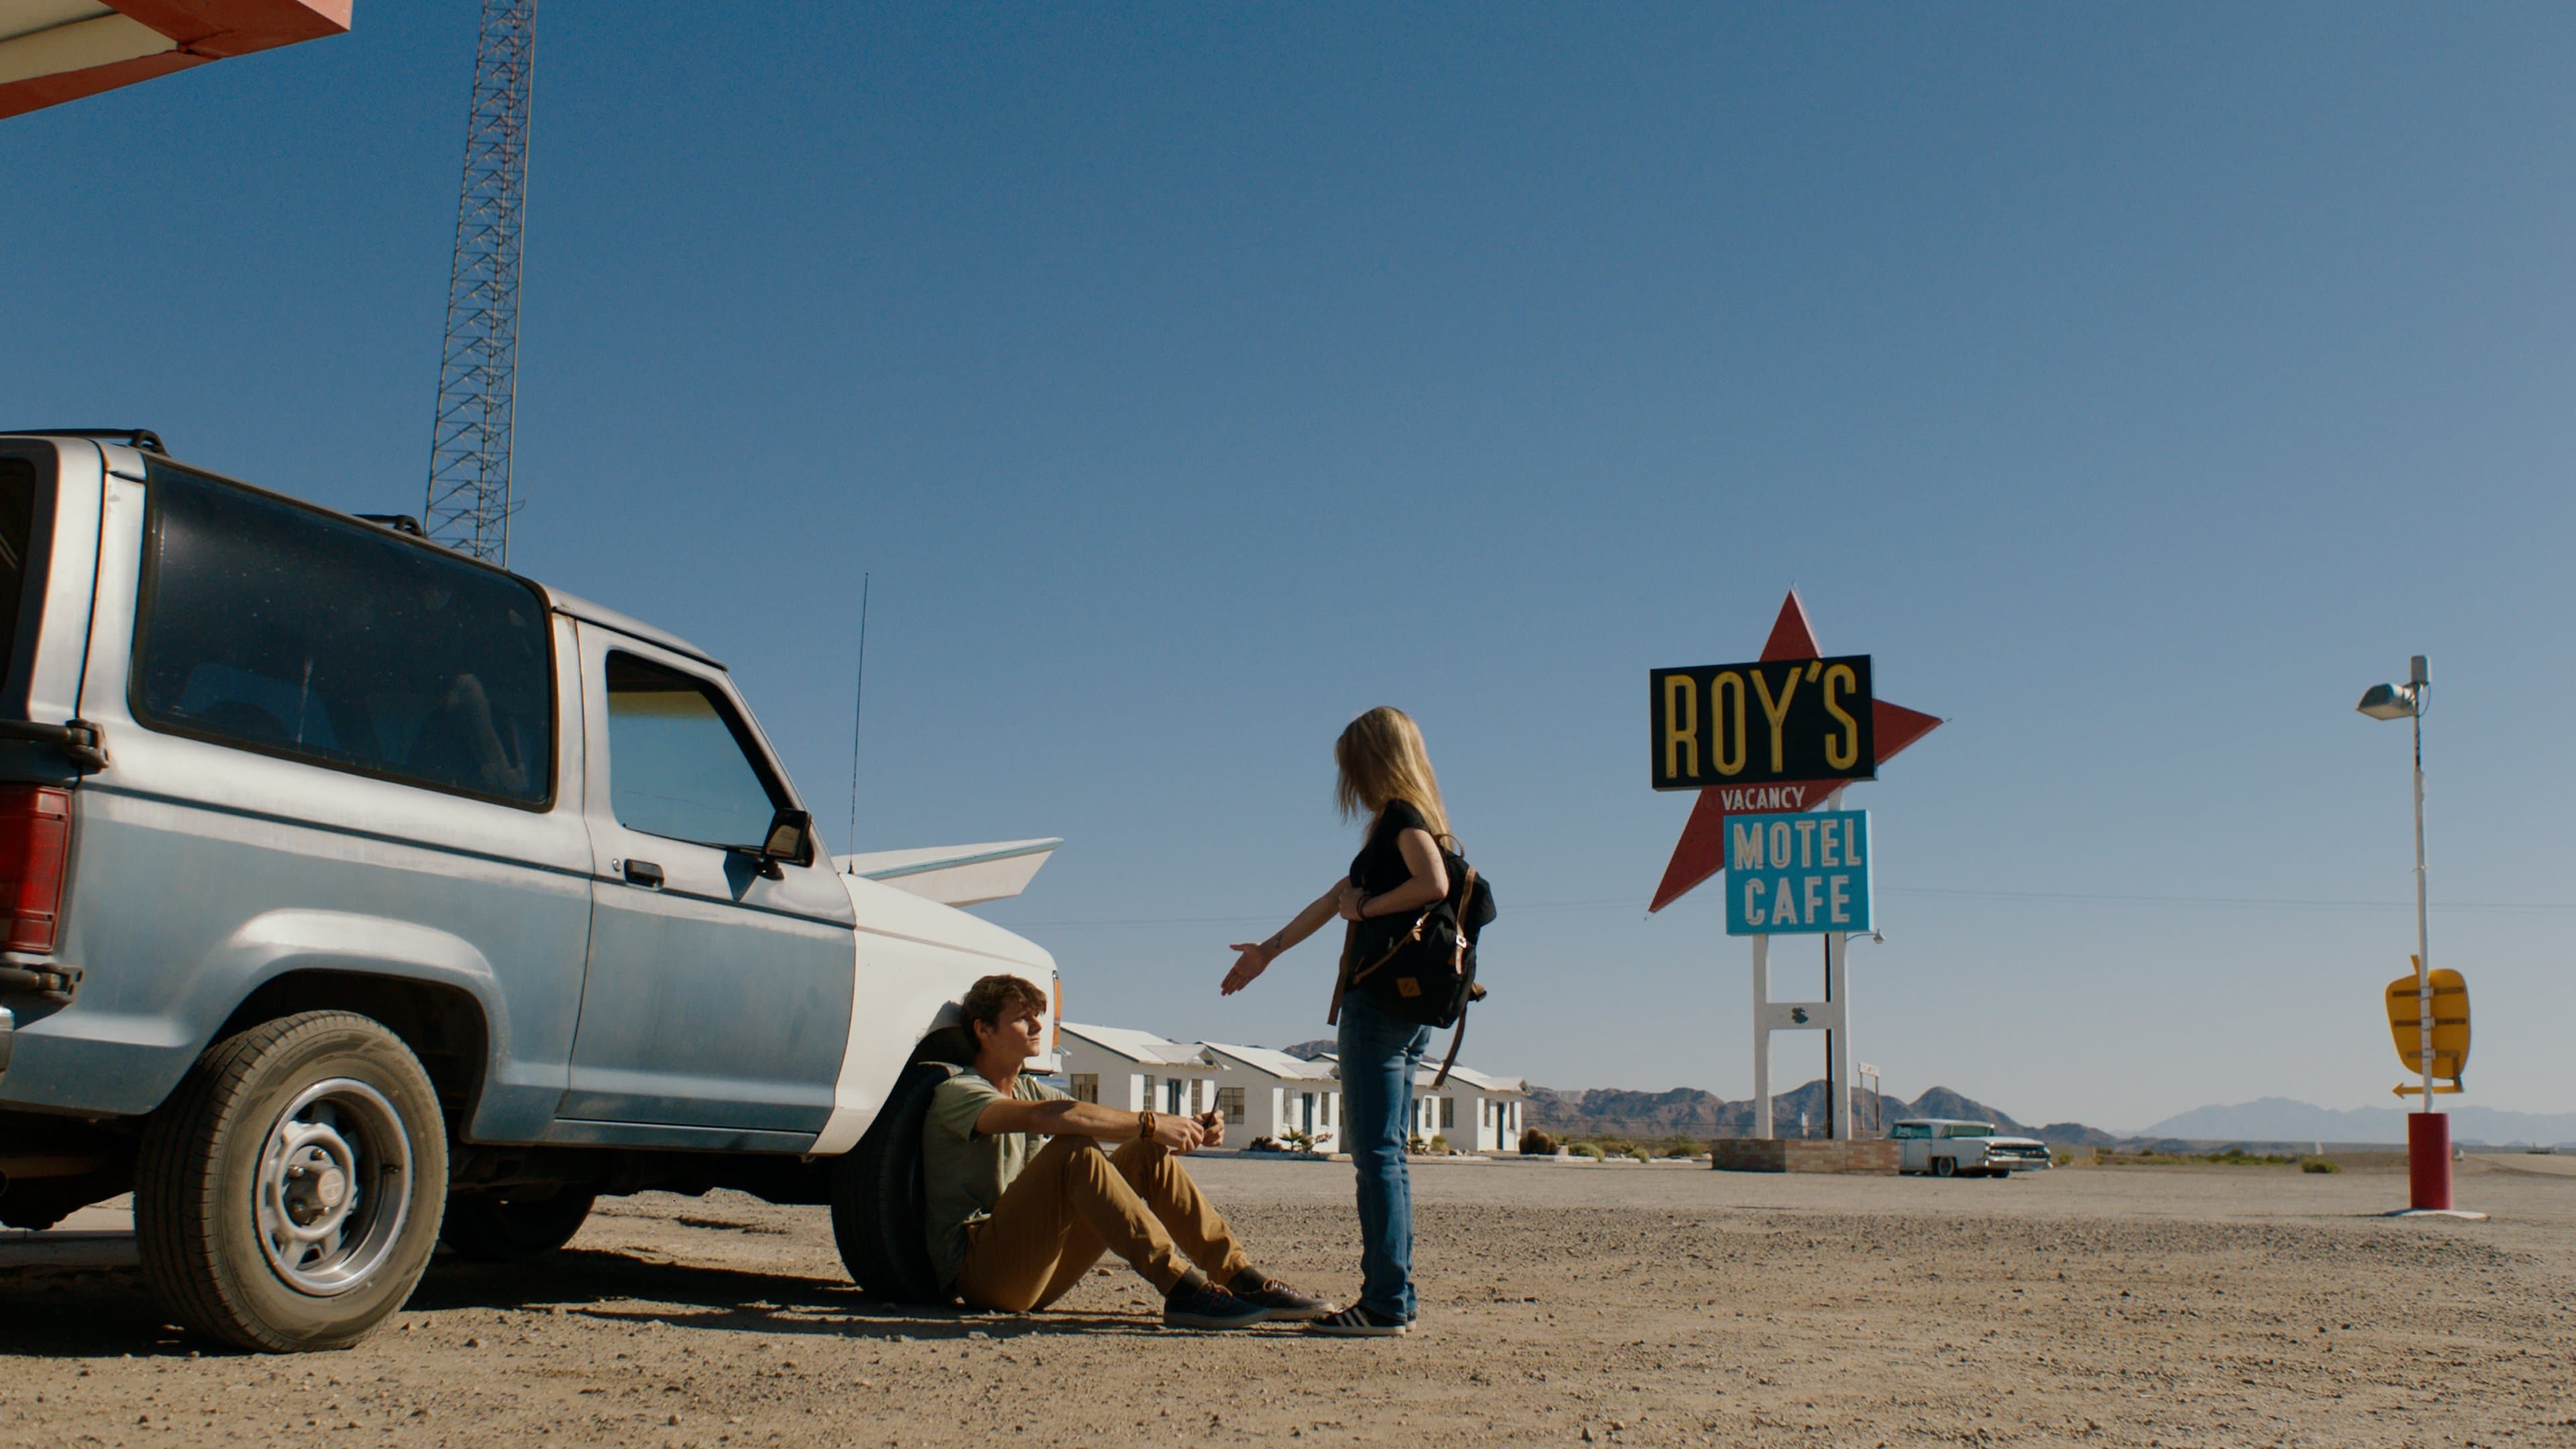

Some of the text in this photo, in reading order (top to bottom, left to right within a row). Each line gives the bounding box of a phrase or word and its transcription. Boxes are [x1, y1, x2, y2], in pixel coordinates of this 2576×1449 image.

[1664, 661, 1859, 778] ROY'S
[1721, 786, 1806, 810] VACANCY
[1733, 818, 1862, 870] MOTEL
[1745, 875, 1851, 926] CAFE
